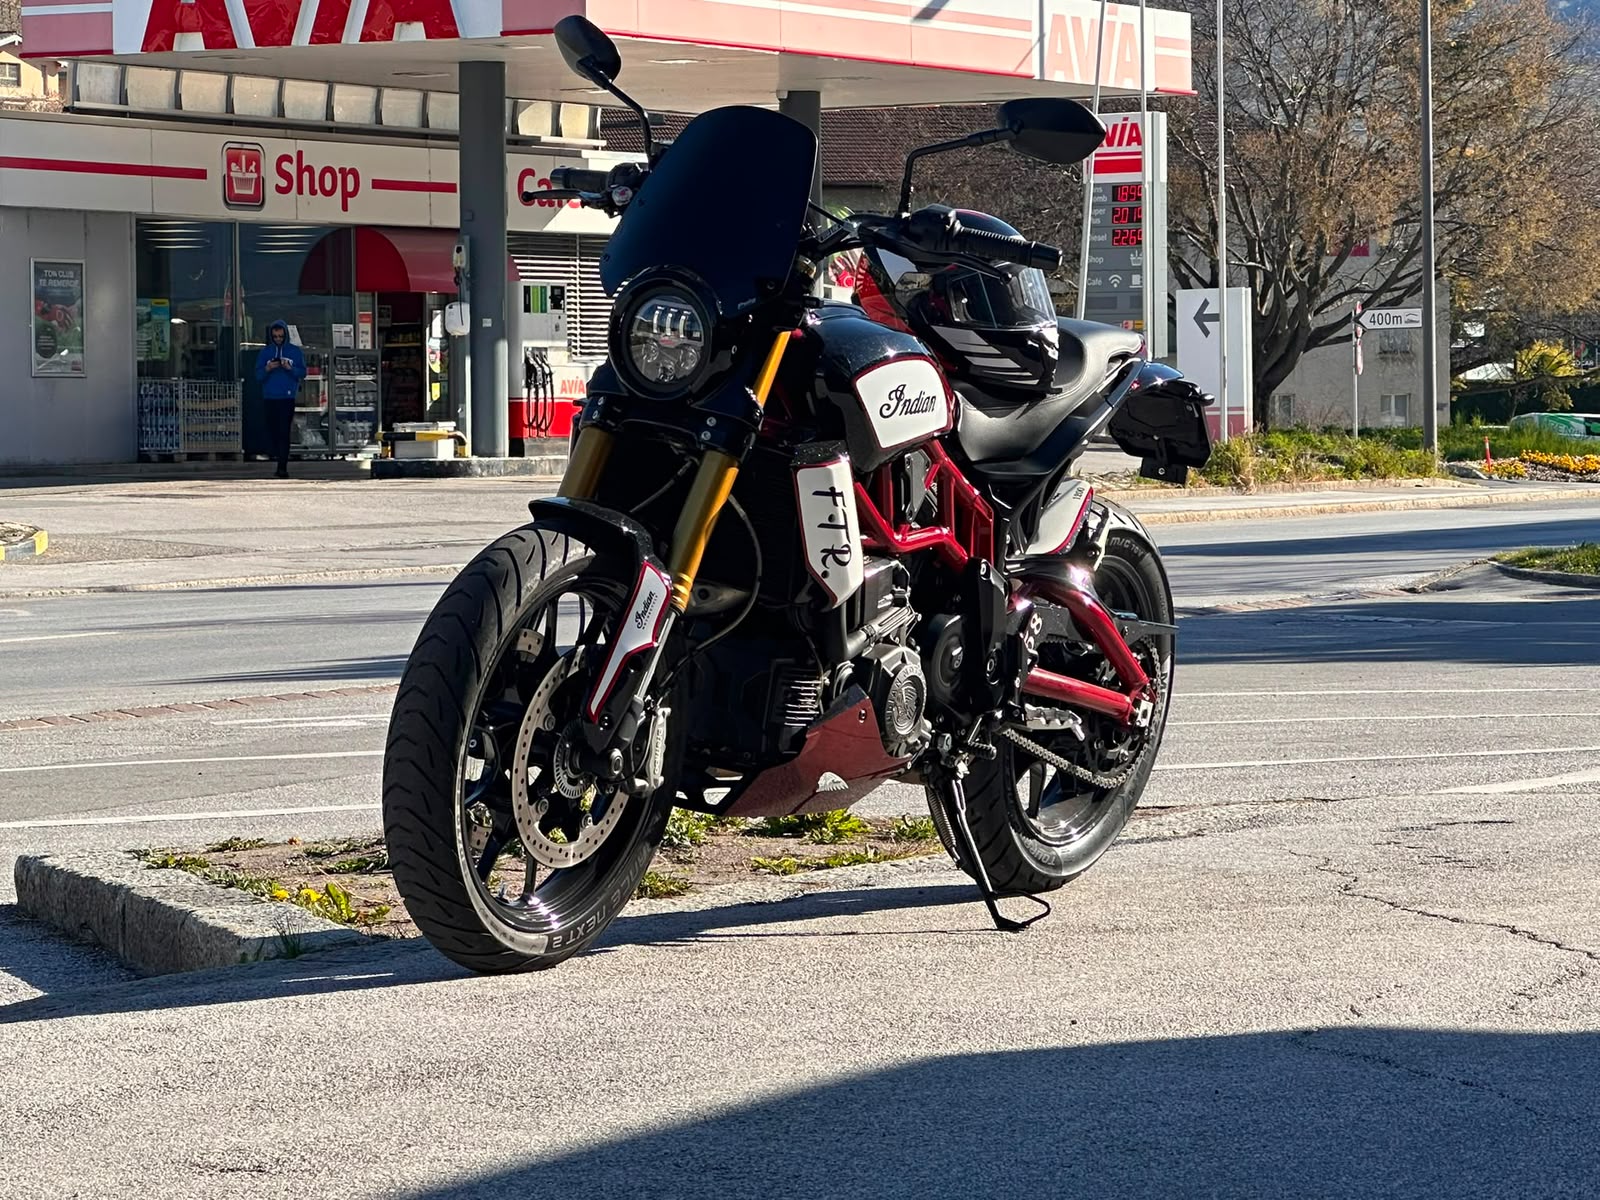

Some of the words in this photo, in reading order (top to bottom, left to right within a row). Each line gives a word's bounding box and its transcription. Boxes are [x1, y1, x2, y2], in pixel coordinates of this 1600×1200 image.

[275, 150, 360, 212] Shop
[1369, 313, 1402, 326] 400m
[879, 383, 937, 419] Indian
[634, 591, 656, 629] Indian
